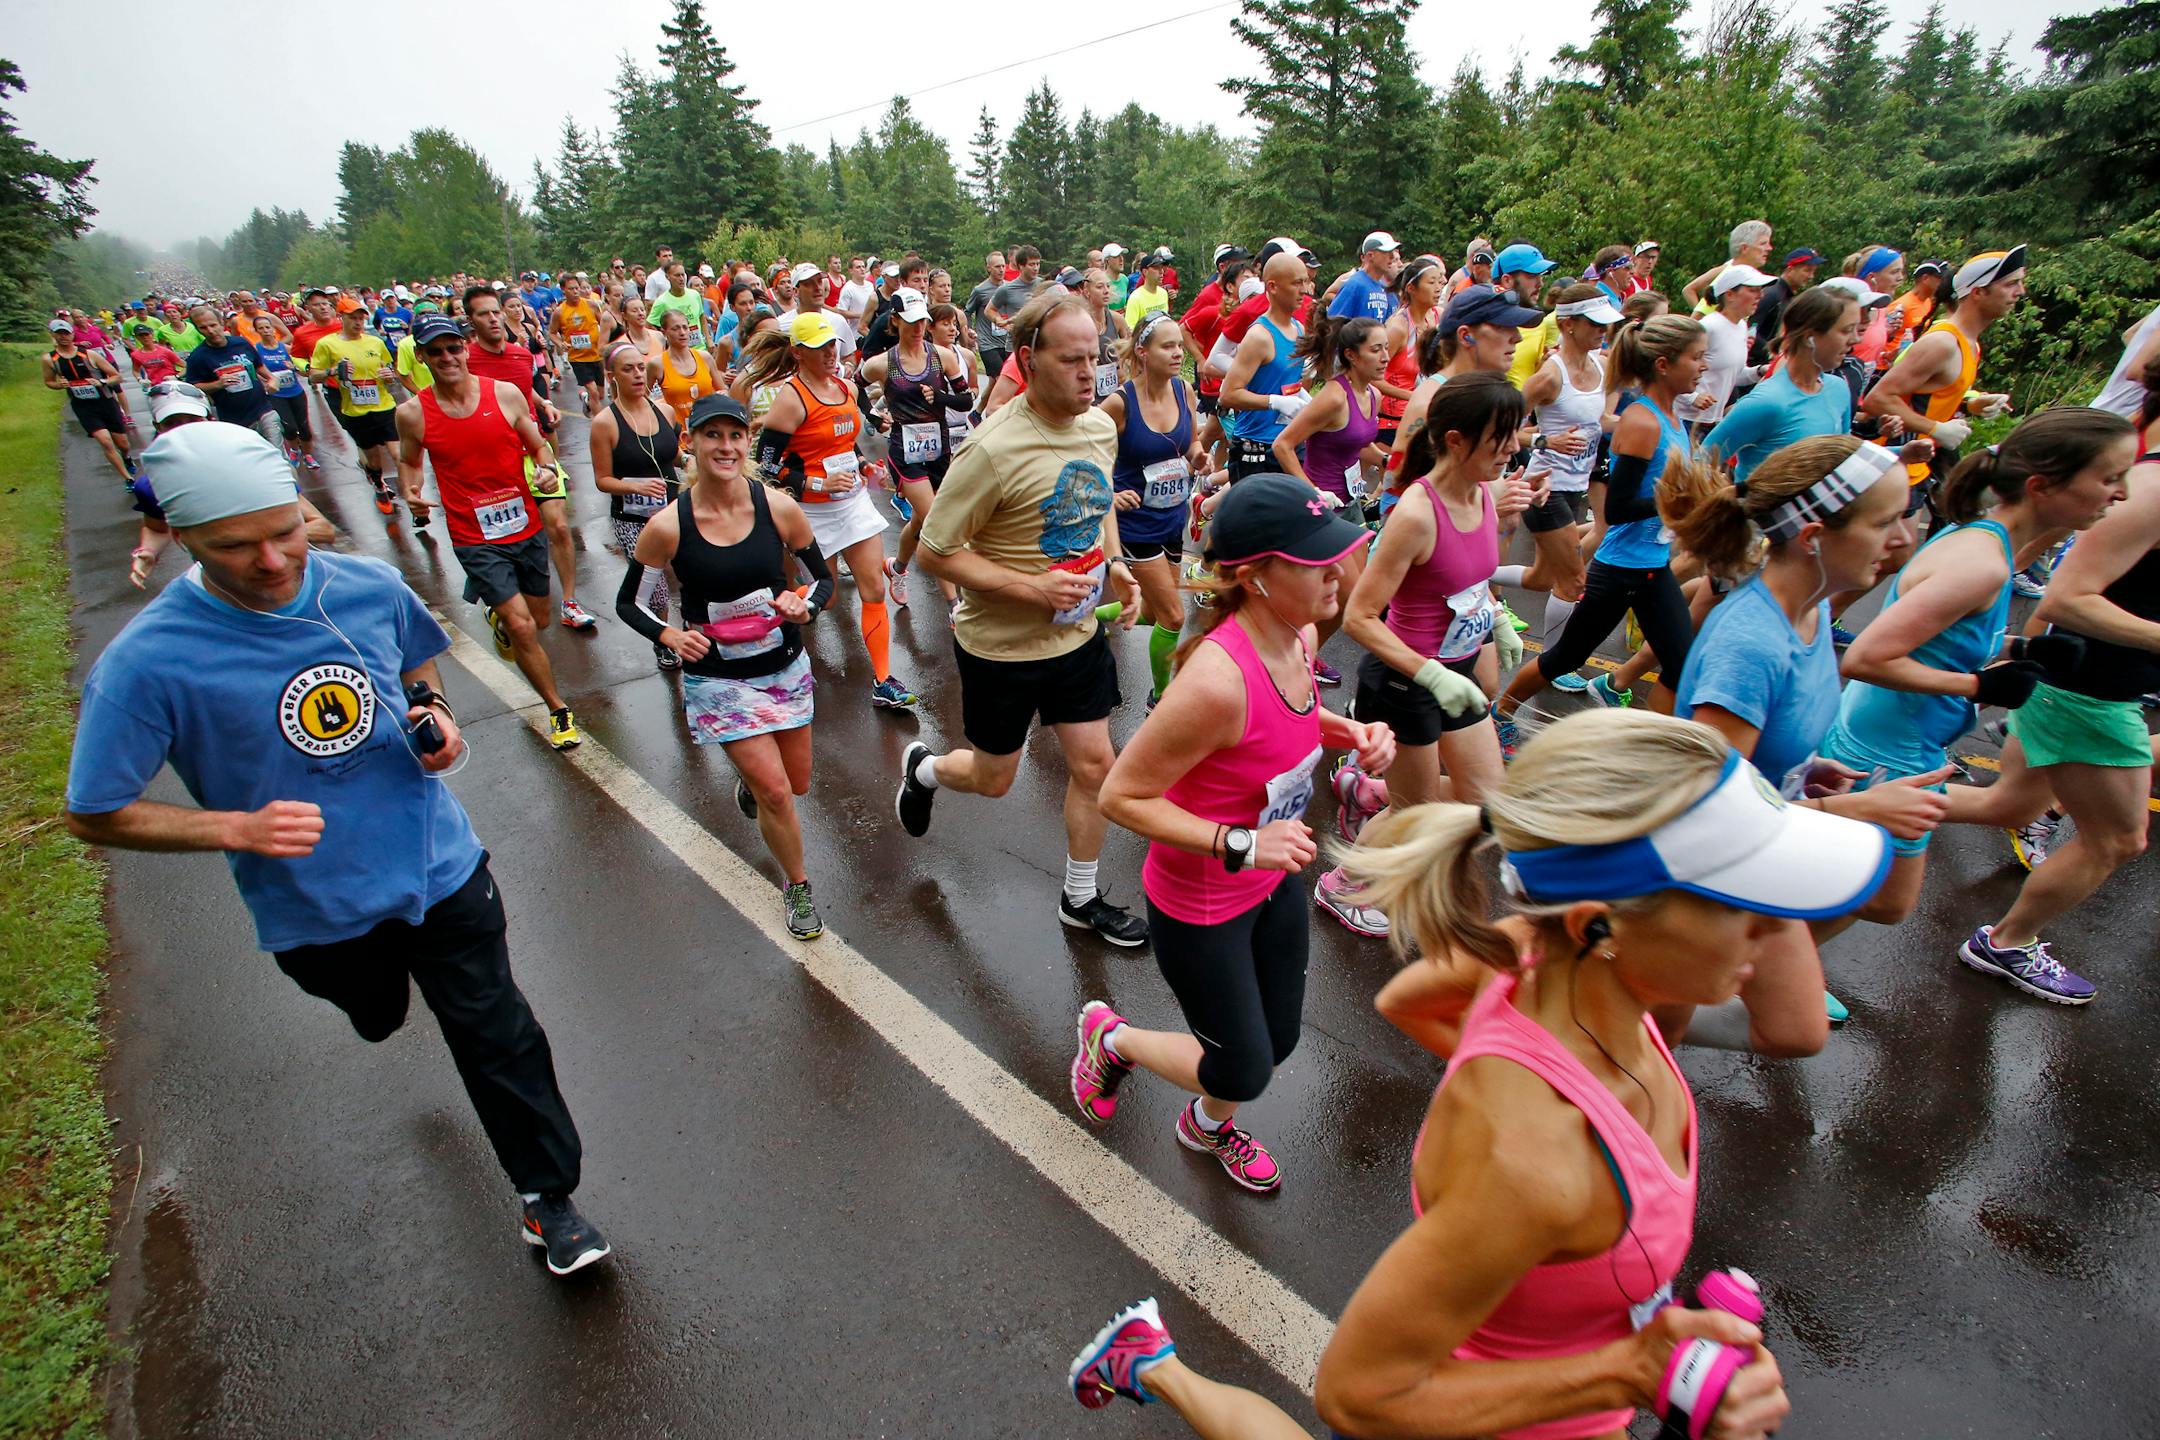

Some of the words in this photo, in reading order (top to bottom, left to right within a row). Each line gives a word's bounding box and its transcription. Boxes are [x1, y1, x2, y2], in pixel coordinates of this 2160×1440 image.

[353, 390, 376, 398] 1469
[908, 439, 938, 453] 8743
[1151, 479, 1184, 497] 6684
[484, 506, 520, 526] 1411
[733, 594, 765, 611] TOYOTA
[284, 677, 310, 710] BEER
[312, 668, 358, 682] BELLY
[288, 723, 337, 752] STORAGE
[342, 692, 370, 747] COMPANY
